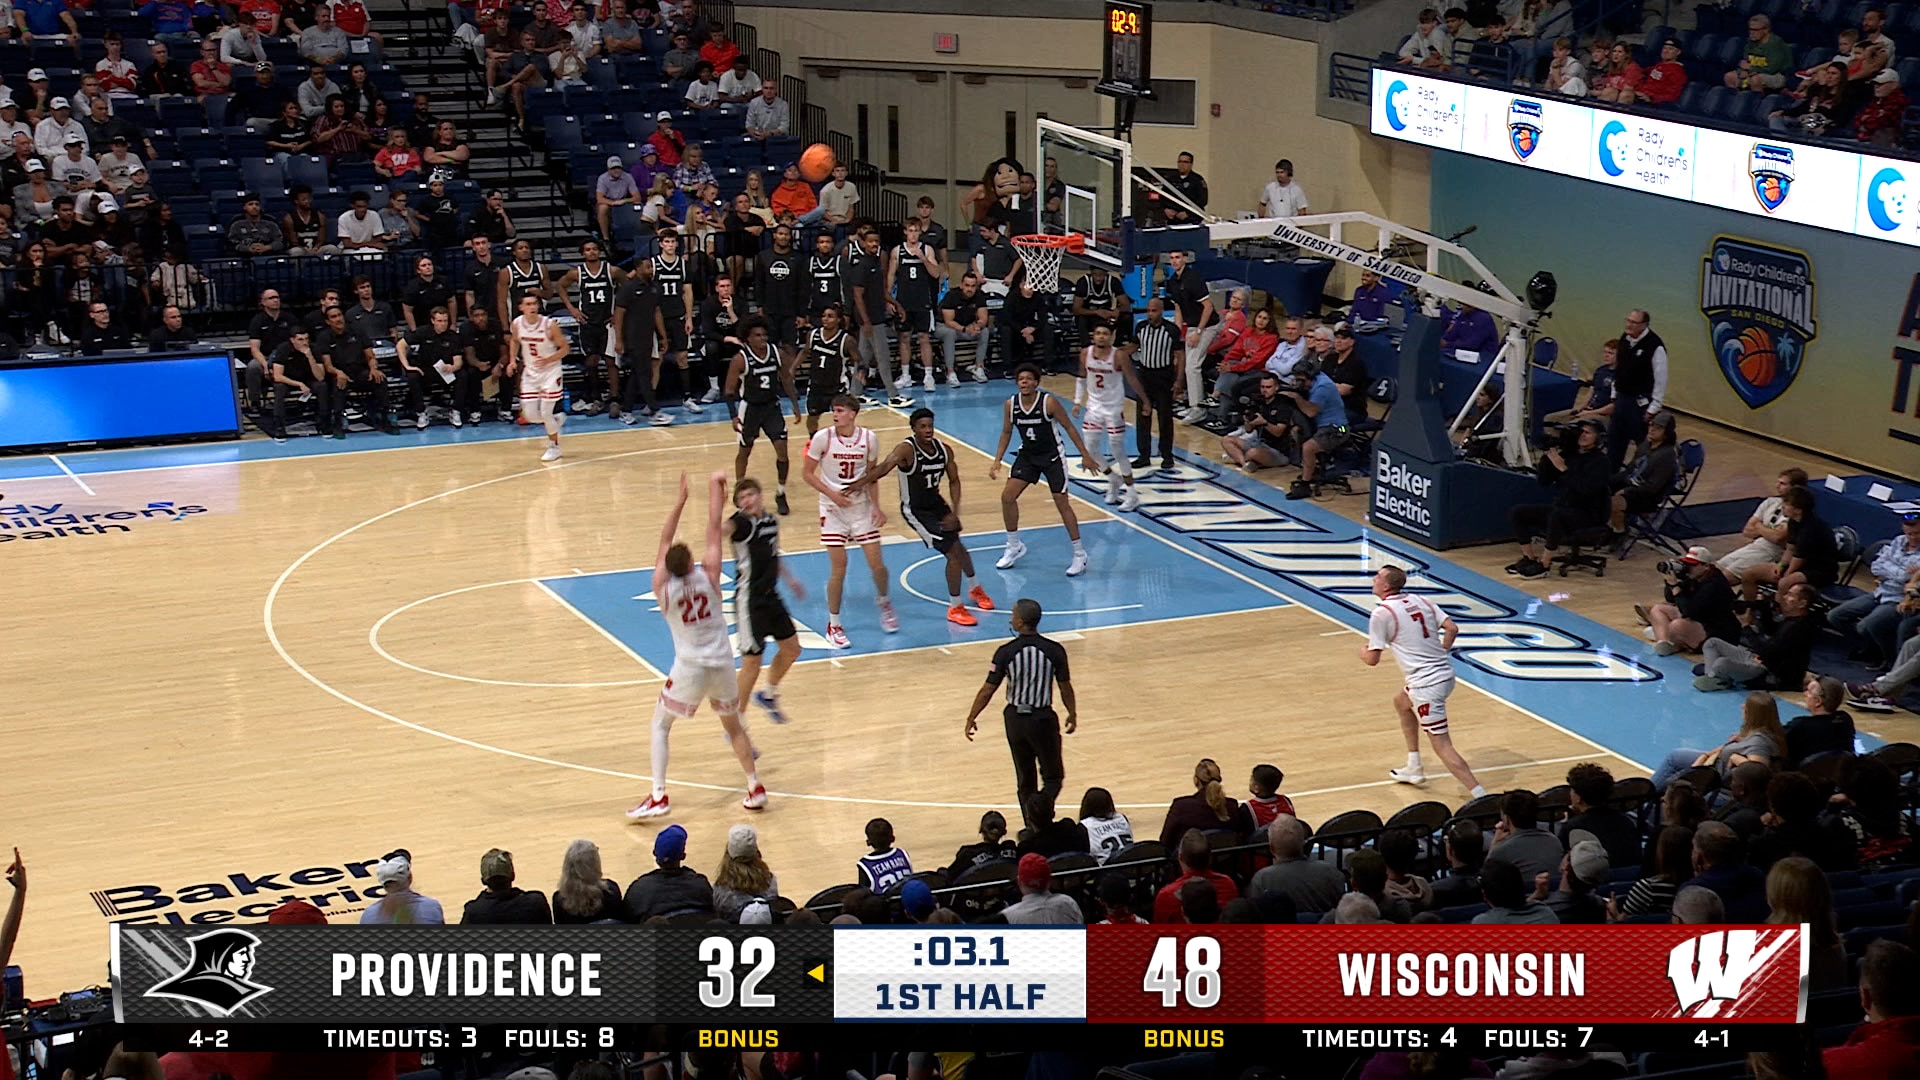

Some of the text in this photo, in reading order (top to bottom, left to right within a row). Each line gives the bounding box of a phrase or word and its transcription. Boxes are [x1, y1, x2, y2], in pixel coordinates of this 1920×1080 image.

[1638, 127, 1664, 149] Rady
[1273, 224, 1422, 284] UNIVERSITY OF SAN DIEGO
[909, 266, 917, 279] 8
[1731, 258, 1757, 279] Rady
[662, 282, 678, 295] 11
[820, 280, 829, 293] 3
[588, 289, 605, 303] 14
[1702, 261, 1815, 338] INVITATIONAL
[1731, 310, 1785, 329] SAN DIEGO
[529, 343, 538, 357] 5
[819, 356, 826, 369] 1
[760, 375, 771, 389] 2
[1095, 374, 1104, 388] 2
[1026, 427, 1036, 440] 4
[838, 461, 855, 479] 31
[1377, 450, 1432, 498] Baker
[0, 504, 63, 516] dy
[1375, 485, 1431, 526] Electric
[0, 523, 131, 541] ealth
[678, 594, 711, 623] 22
[1410, 612, 1430, 638] 7
[872, 861, 890, 875] TEAM
